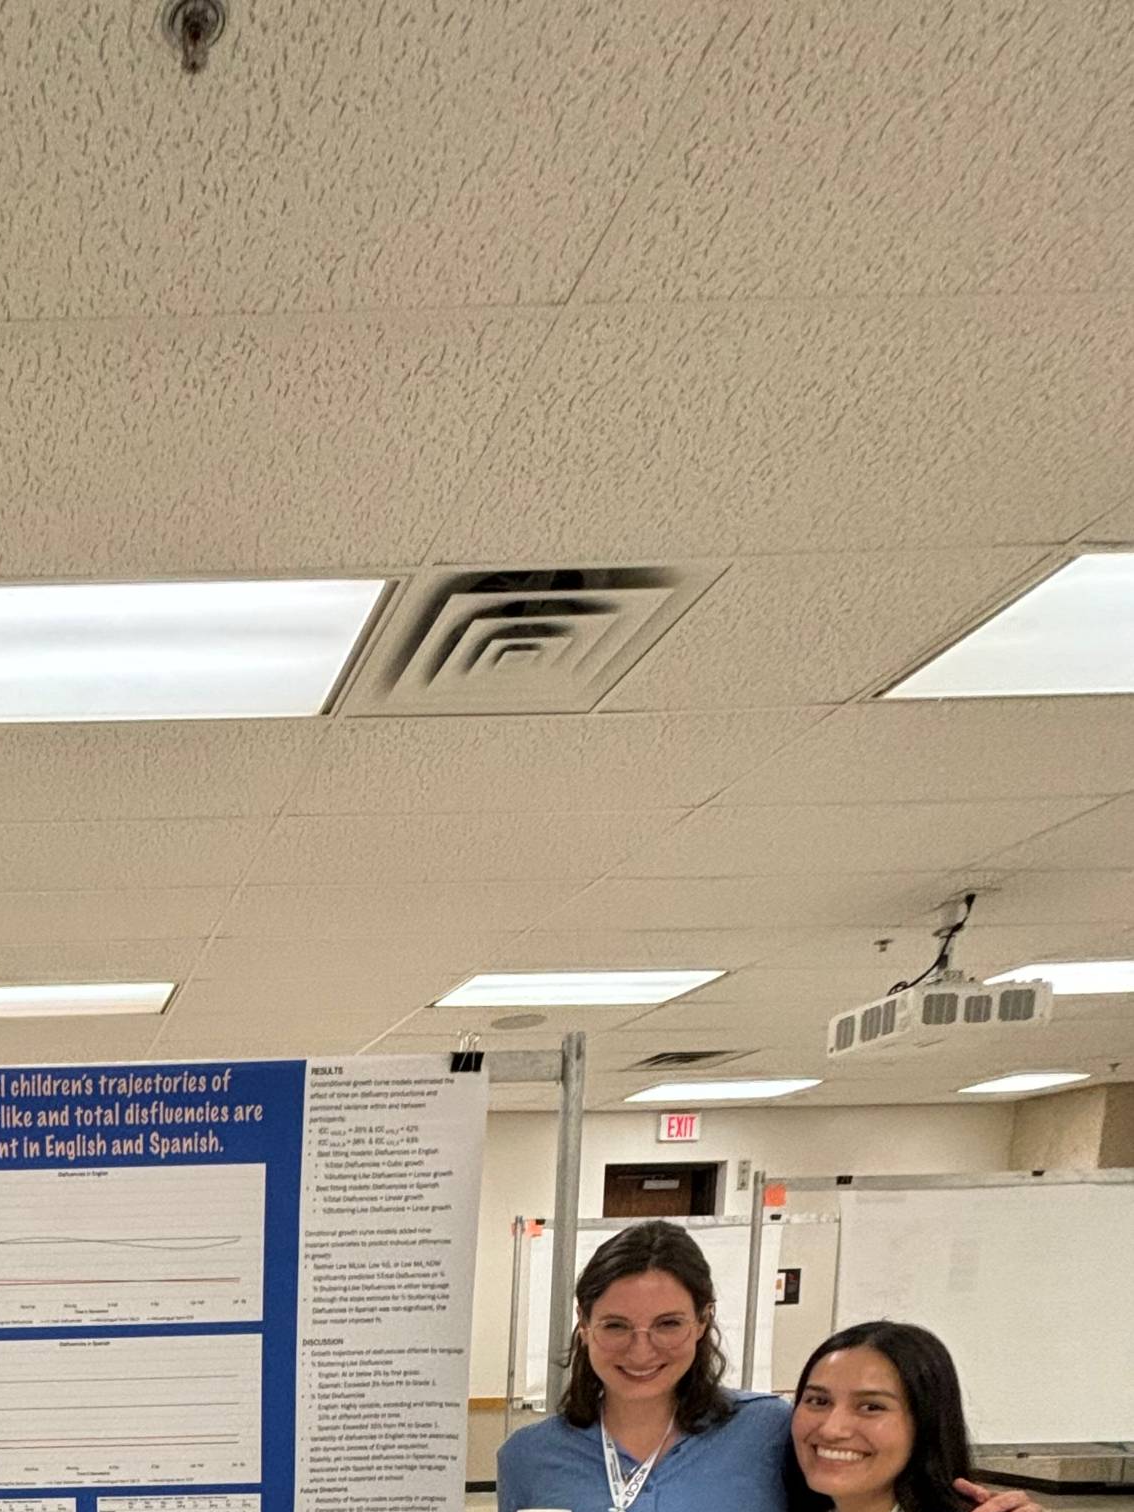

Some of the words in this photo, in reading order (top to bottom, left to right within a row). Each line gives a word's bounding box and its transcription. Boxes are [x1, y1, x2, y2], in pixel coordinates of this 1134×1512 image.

[311, 1067, 343, 1075] RESULTS
[10, 1071, 94, 1098] children's
[98, 1069, 207, 1096] trajectories
[211, 1069, 232, 1093] of
[37, 1105, 70, 1128] and
[74, 1104, 120, 1126] total
[124, 1102, 230, 1125] disfluencies
[233, 1104, 264, 1122] are
[668, 1117, 696, 1138] EXIT
[23, 1135, 40, 1157] in
[45, 1134, 107, 1161] English
[111, 1133, 144, 1154] and
[149, 1130, 225, 1158] Spanish.
[302, 1338, 344, 1346] DISCUSSION
